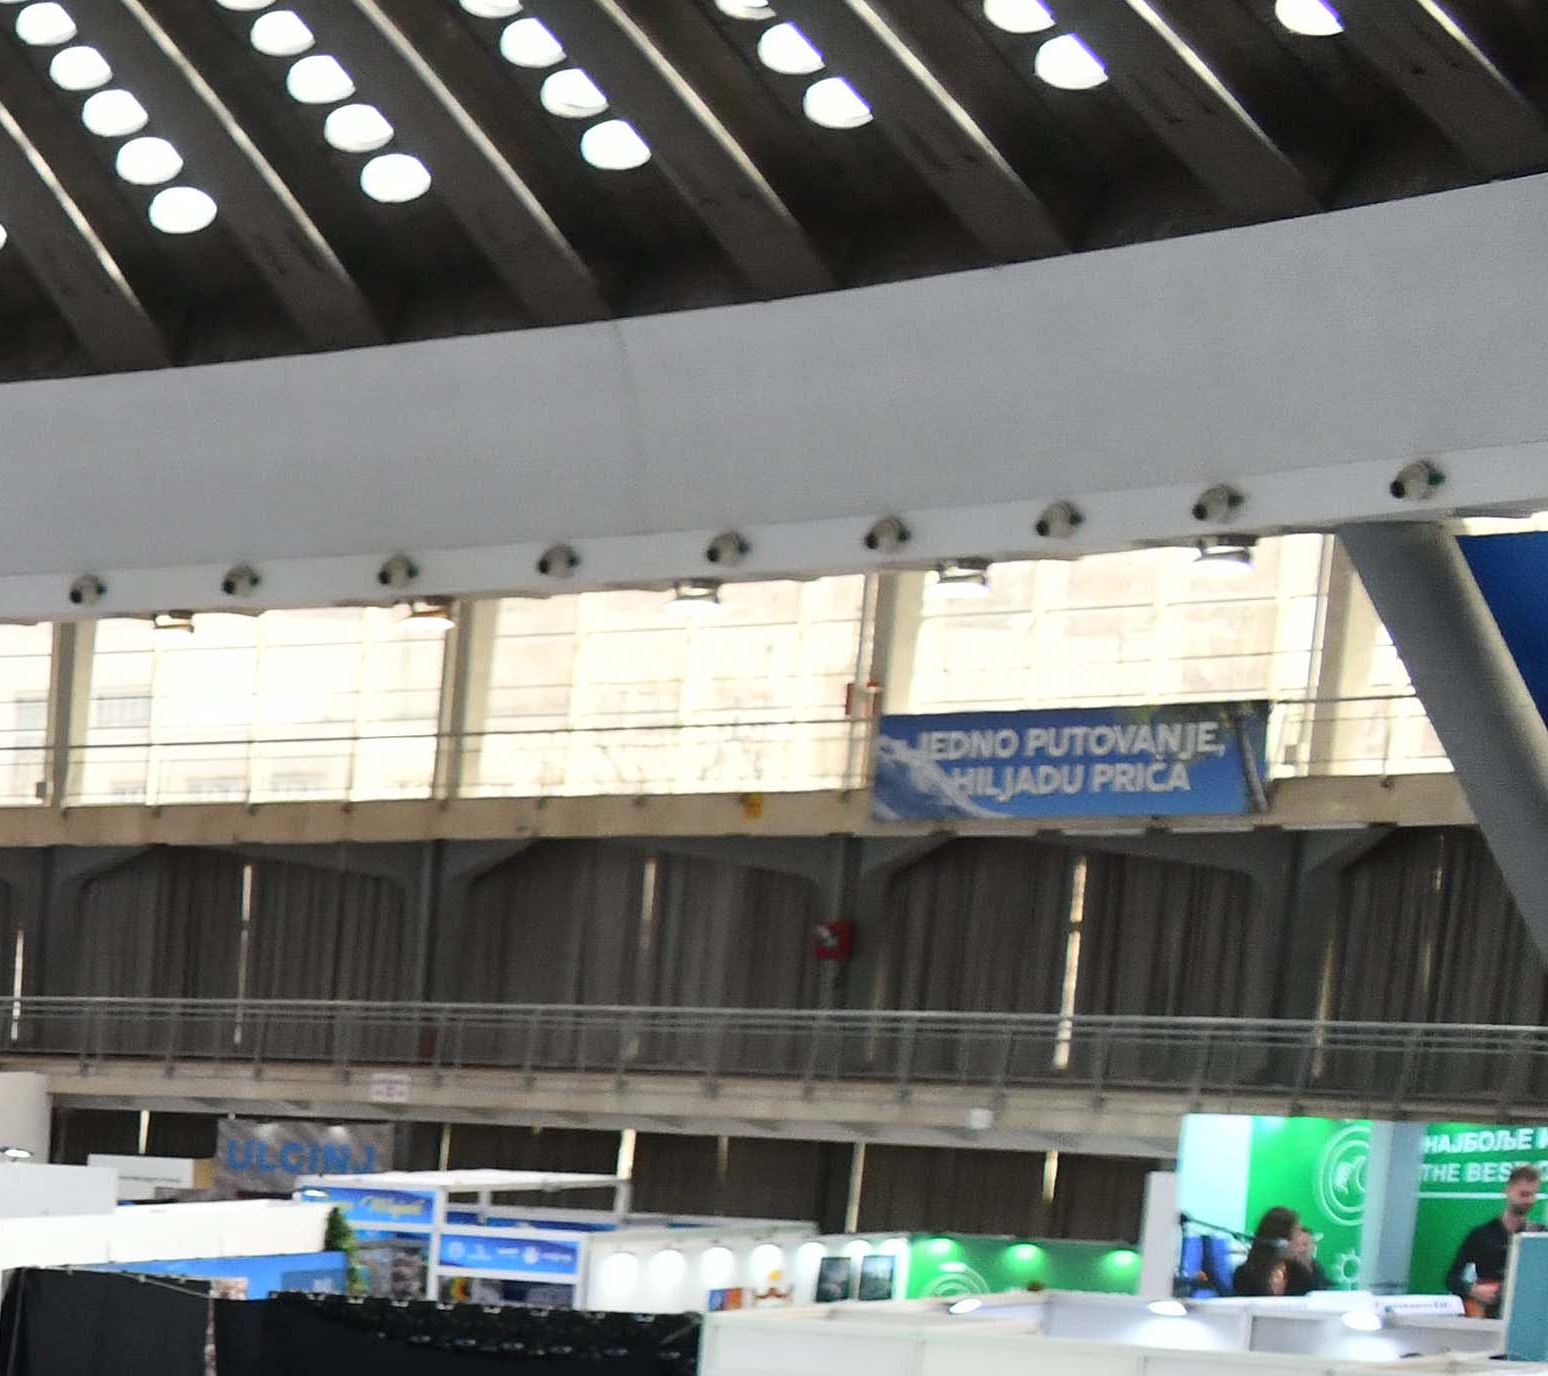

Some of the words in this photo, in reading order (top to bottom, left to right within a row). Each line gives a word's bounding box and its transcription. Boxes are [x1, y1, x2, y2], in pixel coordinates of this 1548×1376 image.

[921, 729, 1021, 760] JEDNO
[1025, 722, 1224, 759] PUTOVANJE,
[954, 765, 1083, 801] HILJADU
[1092, 753, 1190, 794] PRIČA
[227, 1137, 375, 1174] ULCINJ
[1423, 1128, 1535, 1155] НАЈБОЉЕ
[1422, 1161, 1461, 1182] THE
[1466, 1160, 1516, 1182] BES
